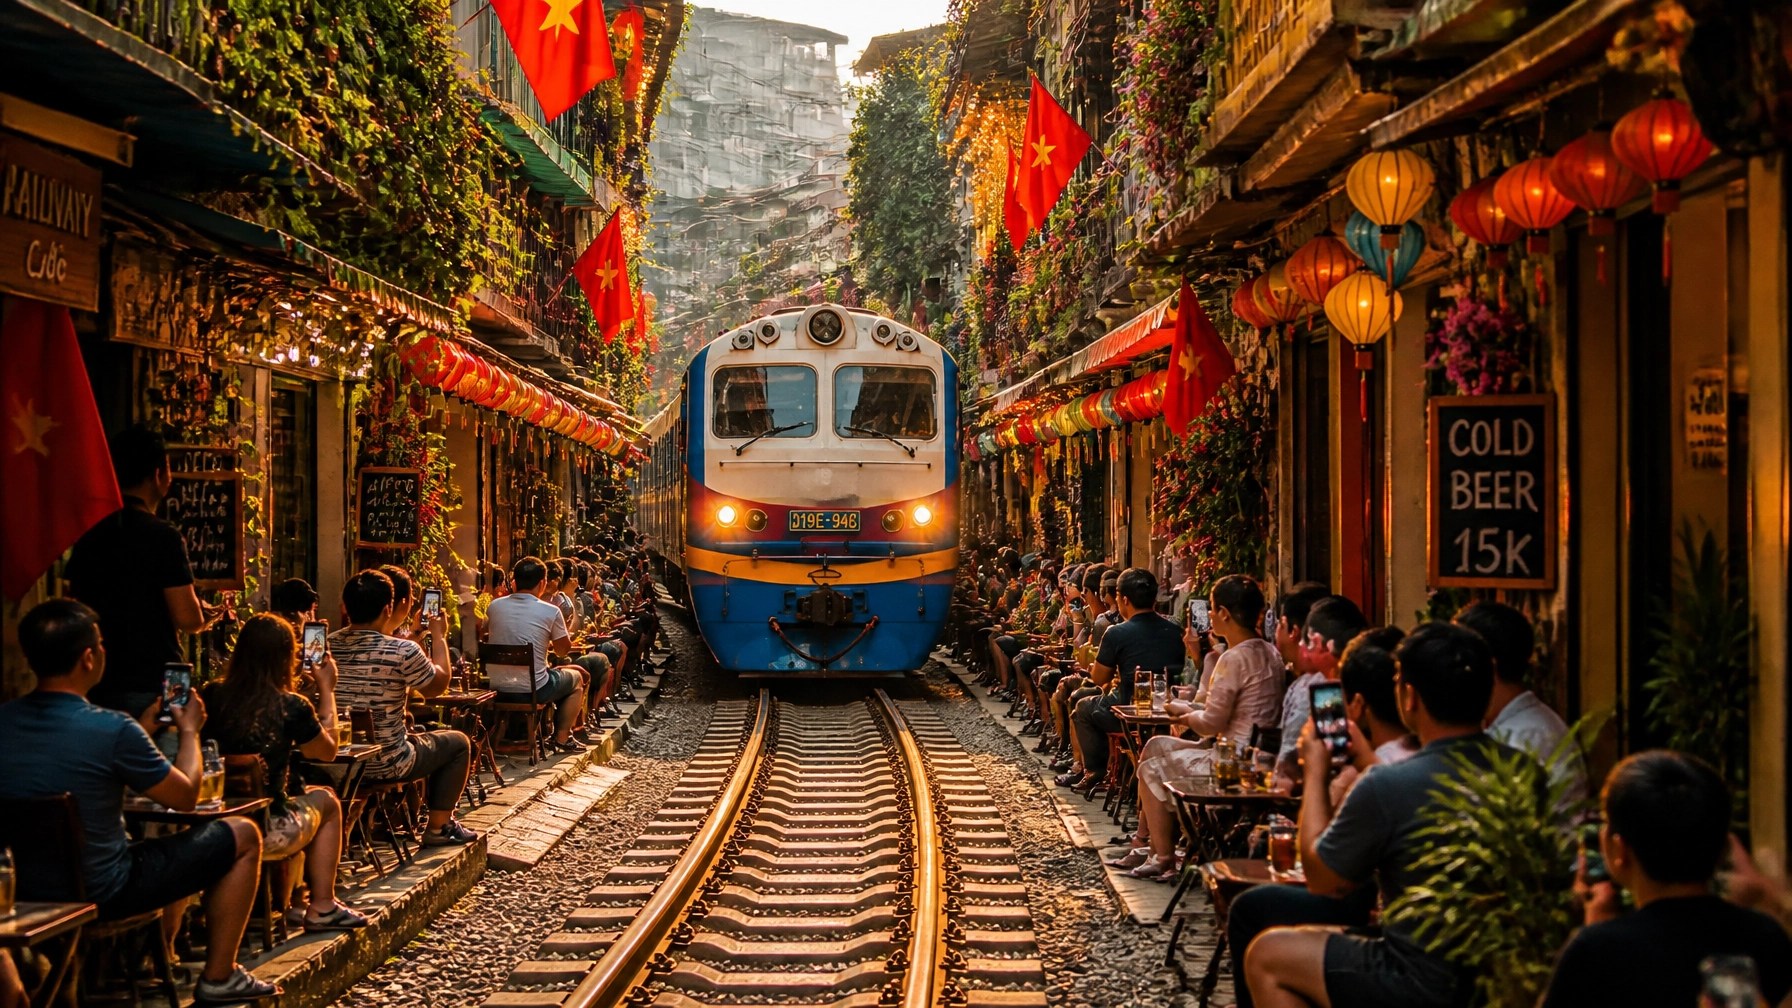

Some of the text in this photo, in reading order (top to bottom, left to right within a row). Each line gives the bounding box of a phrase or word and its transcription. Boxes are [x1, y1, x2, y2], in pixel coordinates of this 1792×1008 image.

[1448, 418, 1535, 457] COLD
[1451, 469, 1539, 513] BEER
[1453, 527, 1533, 575] 15K
